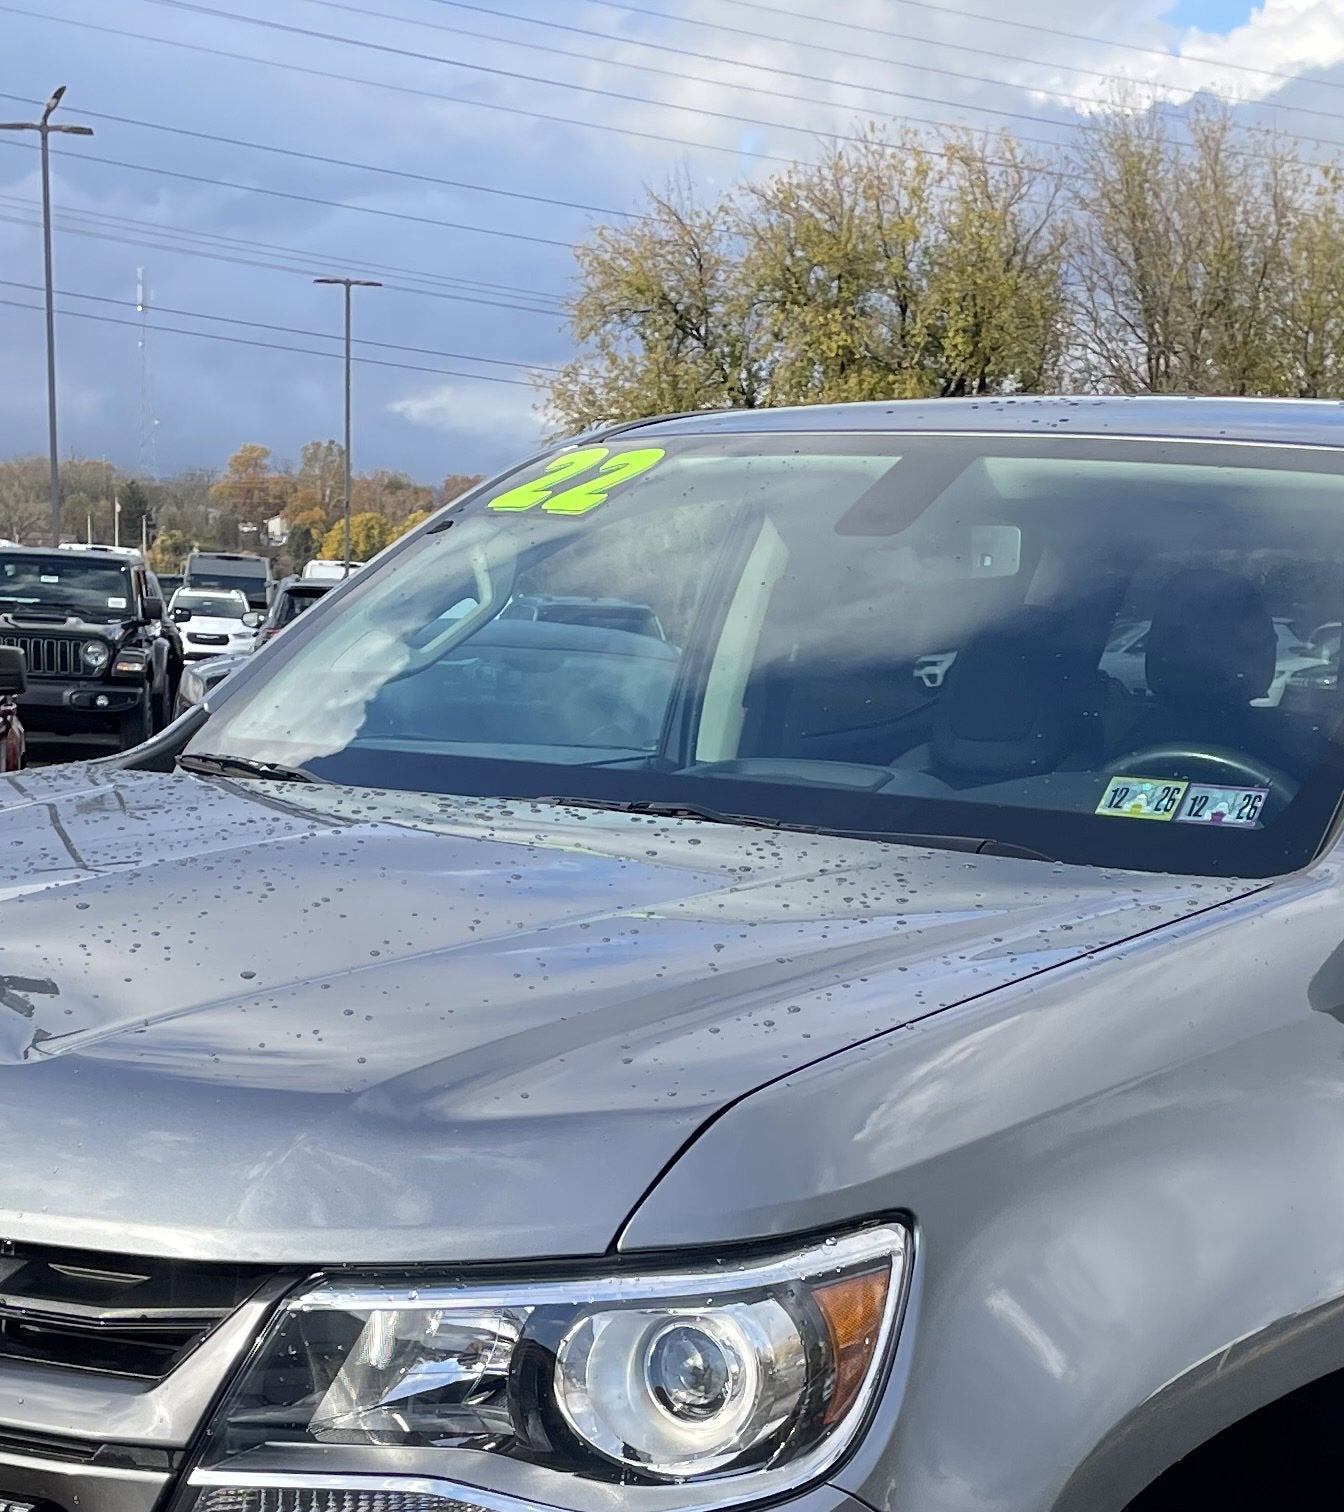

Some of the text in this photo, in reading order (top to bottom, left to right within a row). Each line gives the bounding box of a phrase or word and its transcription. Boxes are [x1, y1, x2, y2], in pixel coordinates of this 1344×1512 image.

[487, 448, 666, 516] 22
[1107, 787, 1130, 809] 12
[1187, 795, 1209, 818] 12
